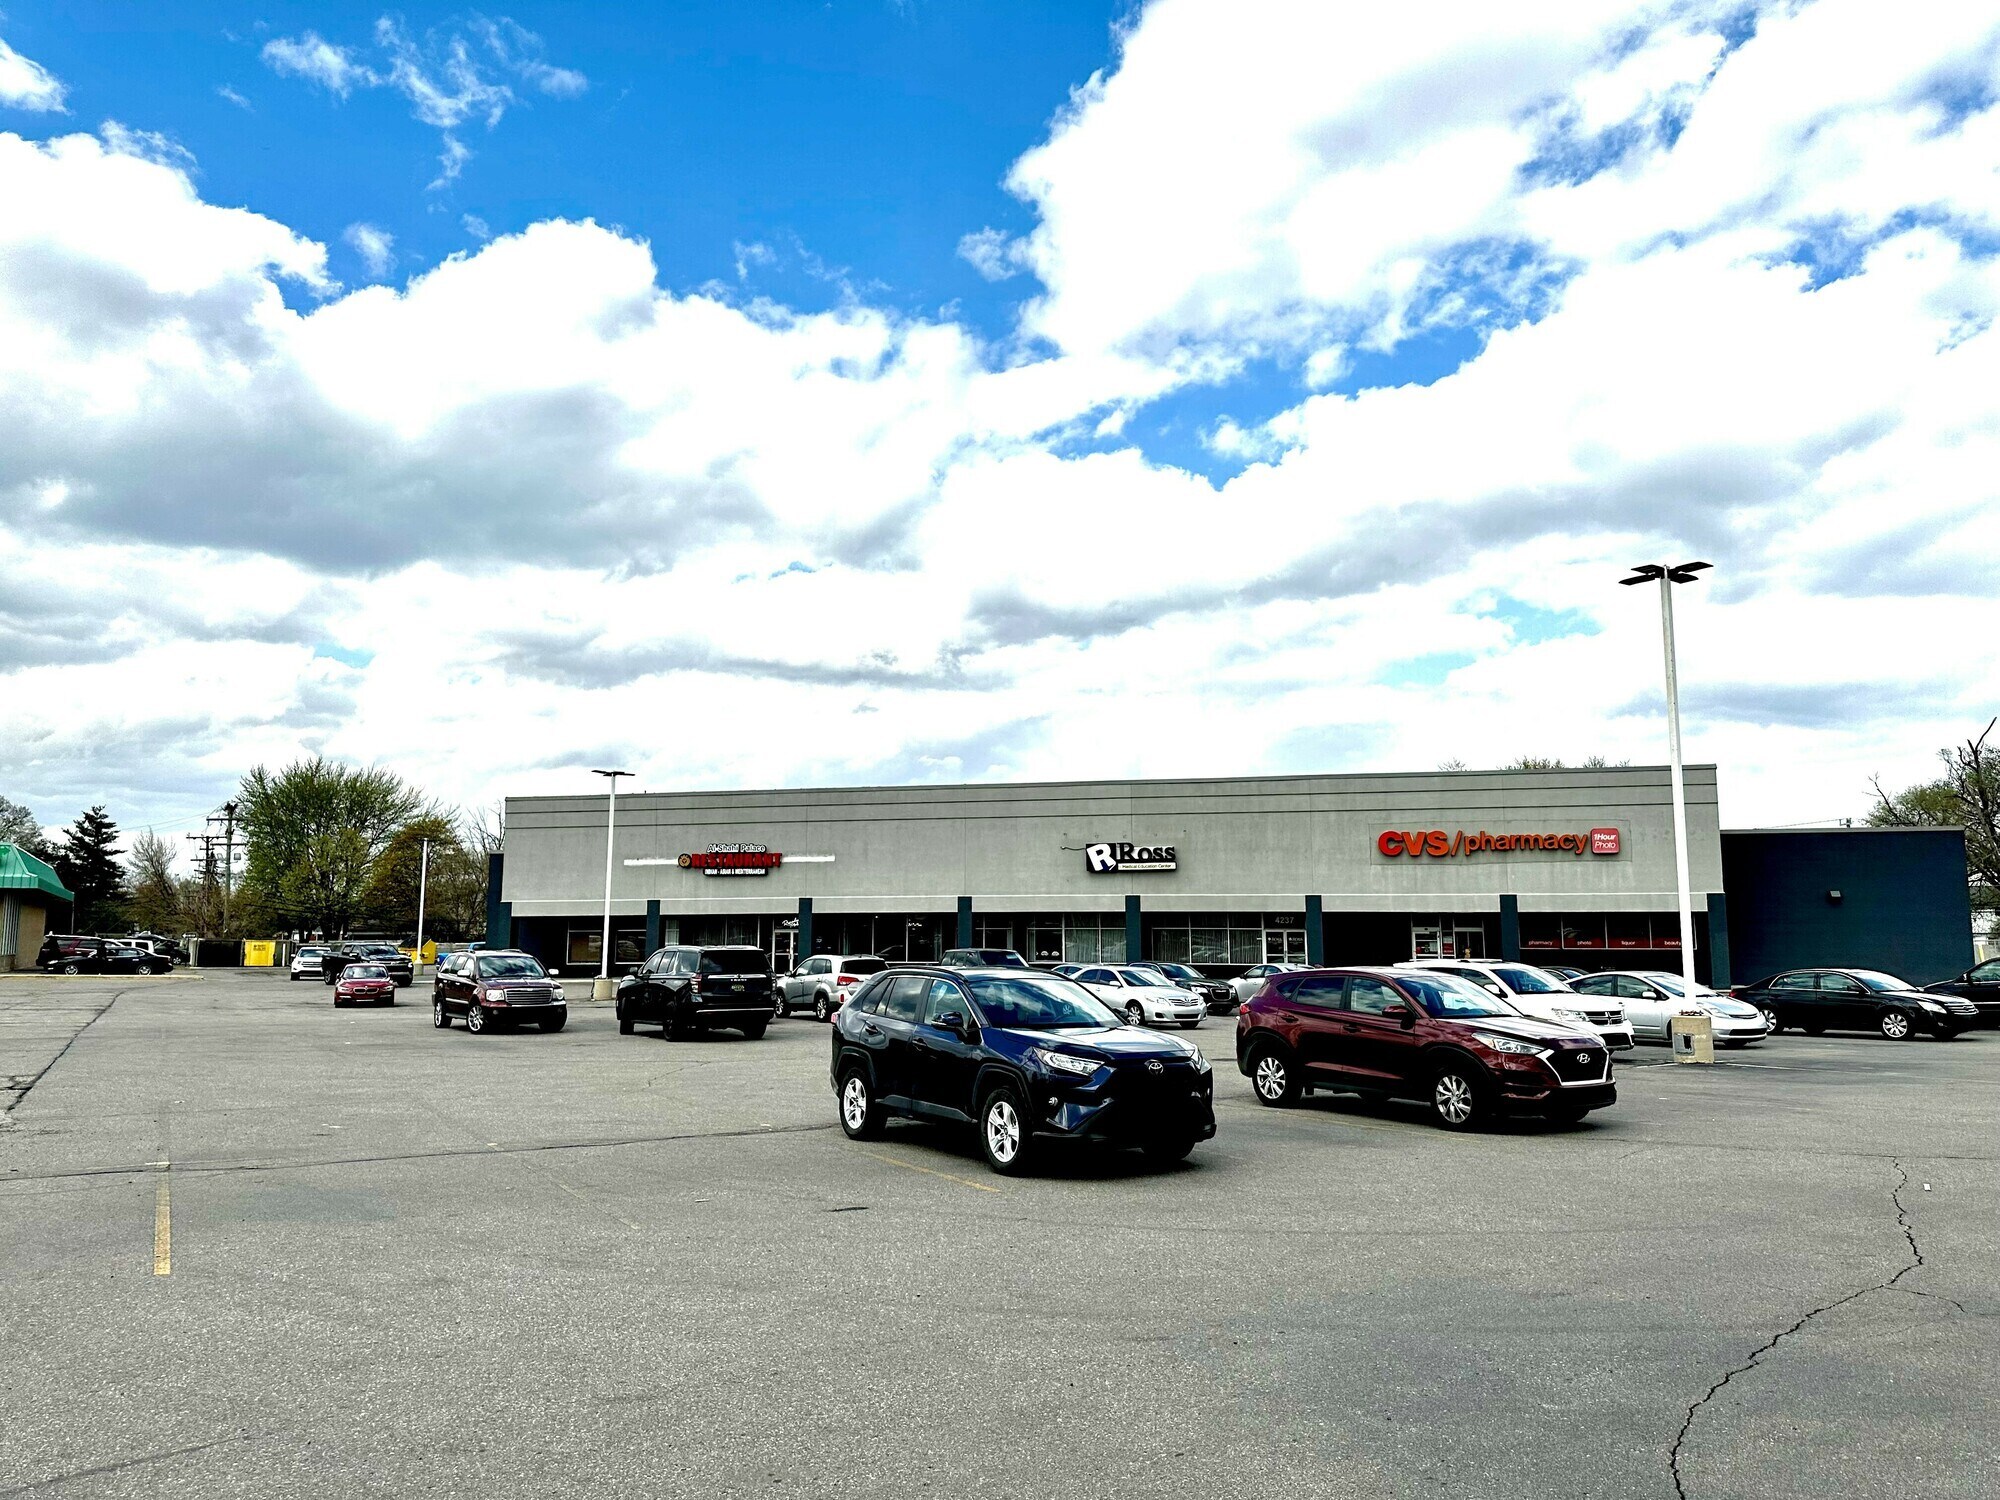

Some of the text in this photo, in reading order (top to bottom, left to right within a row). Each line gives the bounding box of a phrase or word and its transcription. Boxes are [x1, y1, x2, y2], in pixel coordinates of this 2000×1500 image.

[740, 843, 767, 853] Palace
[1595, 841, 1616, 849] Photo
[691, 853, 782, 868] RESTAURANT
[1274, 916, 1295, 924] 4237
